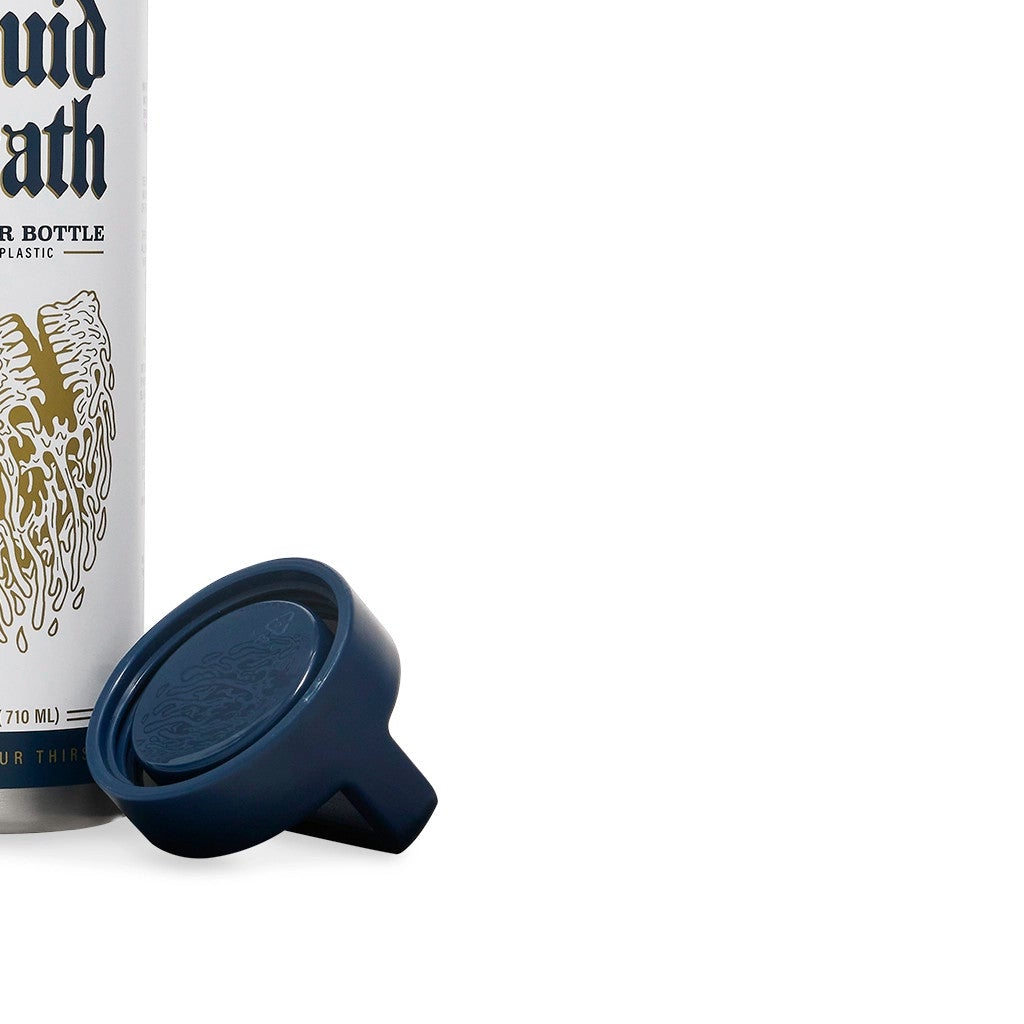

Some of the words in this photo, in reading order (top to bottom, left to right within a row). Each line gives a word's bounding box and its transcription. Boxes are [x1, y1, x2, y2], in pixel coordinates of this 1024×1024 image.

[21, 225, 105, 242] BOTTLE
[0, 247, 54, 259] PLASTIC
[34, 707, 60, 726] ML)
[36, 747, 87, 764] THIRS
